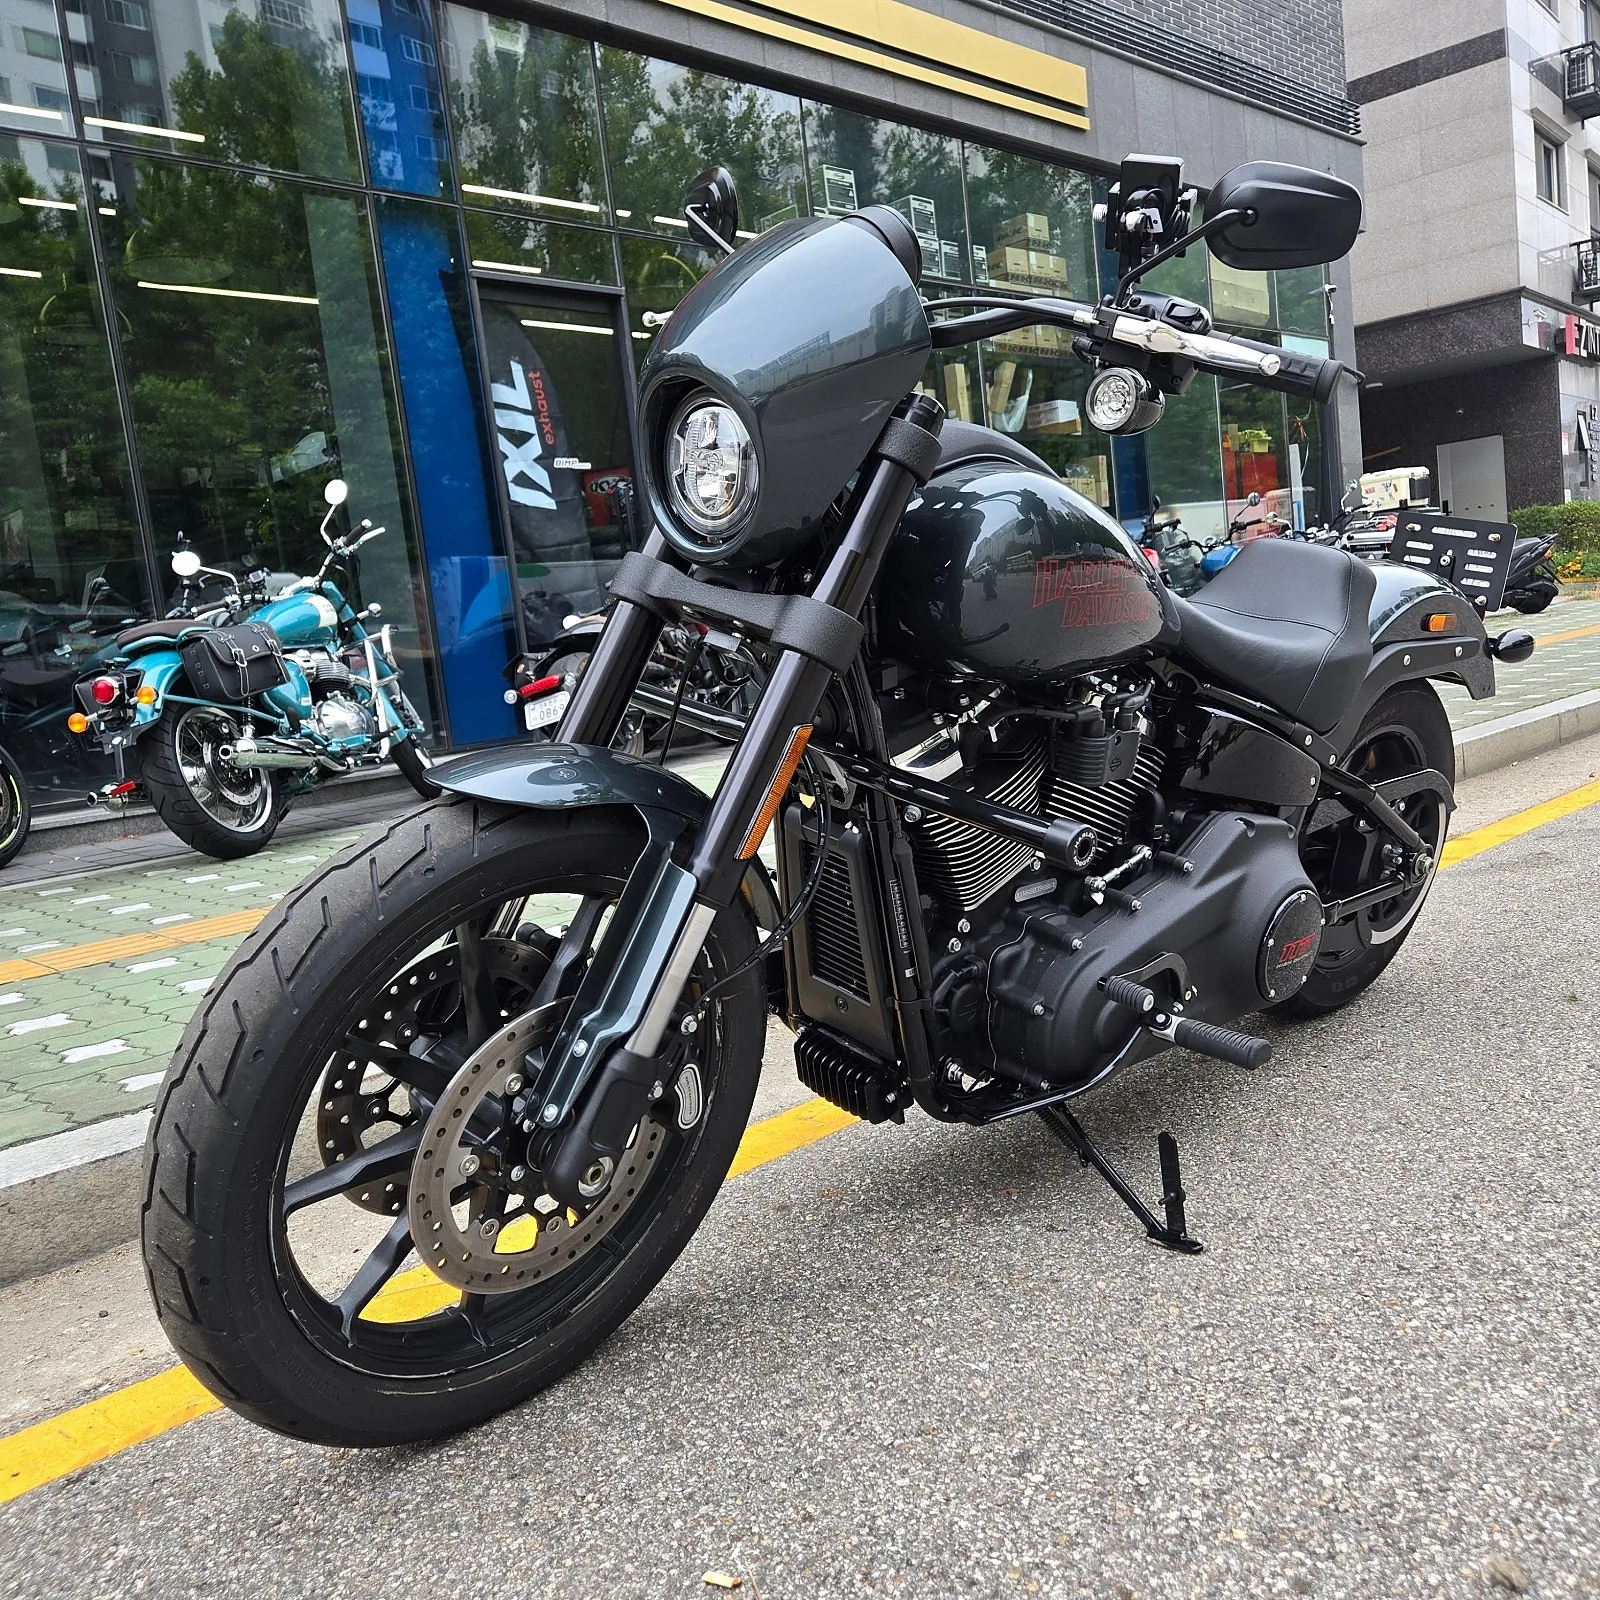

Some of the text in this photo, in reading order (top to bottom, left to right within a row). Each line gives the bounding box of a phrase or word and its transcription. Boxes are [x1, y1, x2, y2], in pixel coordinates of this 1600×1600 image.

[491, 360, 557, 510] IXIL
[528, 371, 556, 445] exhaust
[1061, 591, 1151, 628] DAVIDSON
